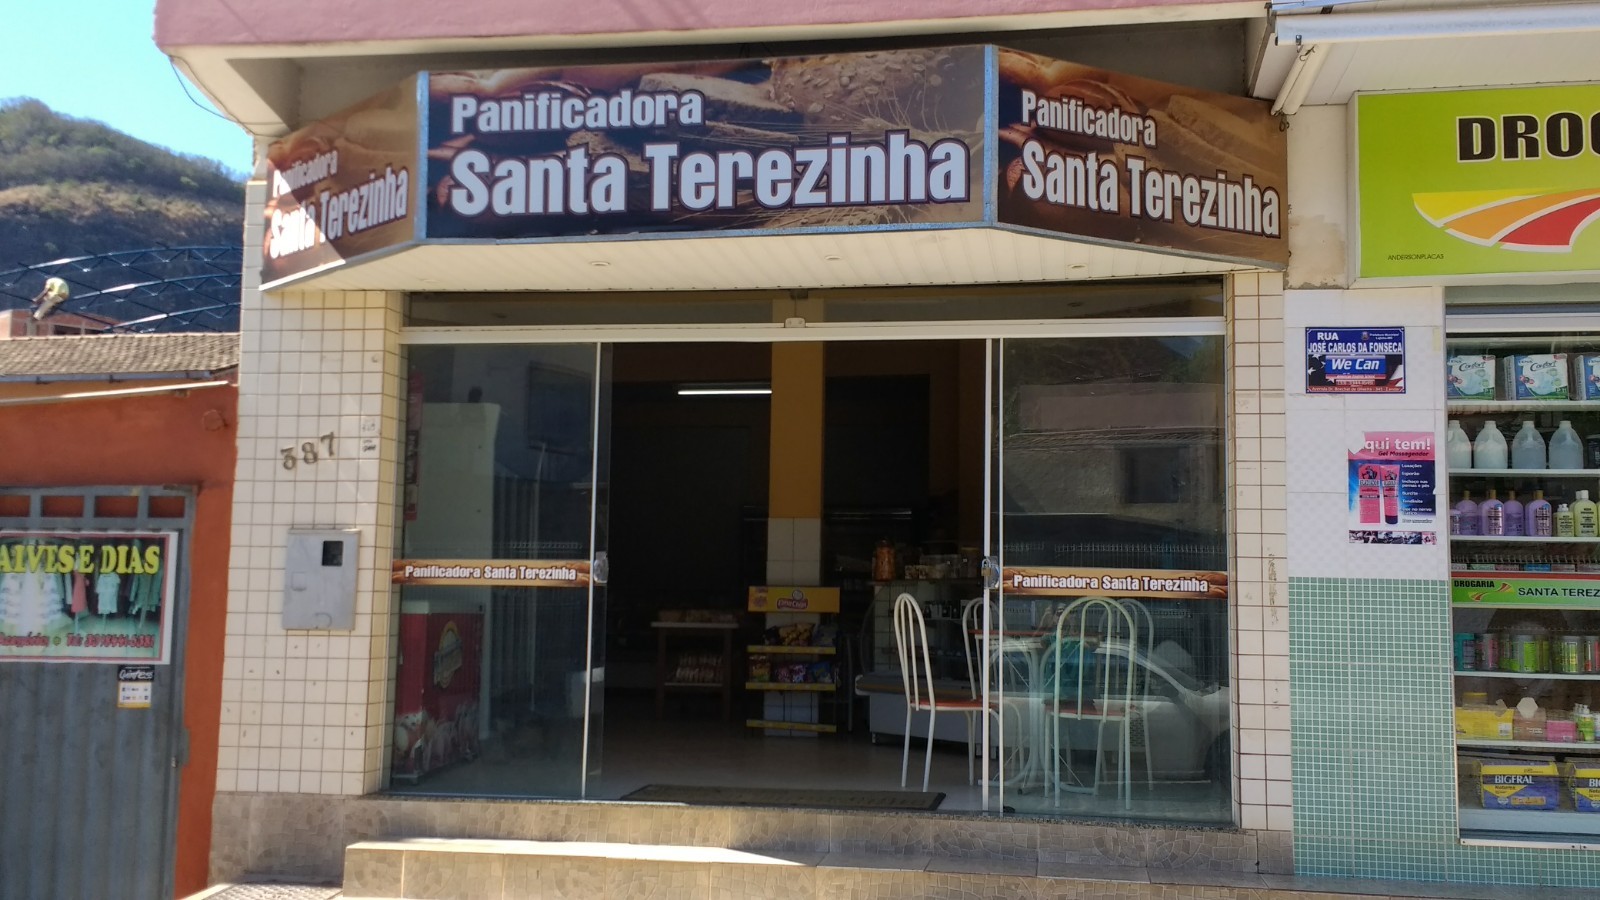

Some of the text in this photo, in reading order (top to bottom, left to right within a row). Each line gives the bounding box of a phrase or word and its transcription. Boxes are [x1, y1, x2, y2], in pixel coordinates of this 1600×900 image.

[452, 89, 703, 133] Panificadora
[1021, 89, 1157, 147] Panificadora
[1456, 110, 1600, 163] DRO
[273, 150, 338, 198] Panificadora
[451, 131, 971, 216] Santa Terezinha
[1022, 139, 1282, 238] Santa Terezinha
[269, 166, 409, 259] Santa Terezinha
[1308, 340, 1402, 353] JOSÉ CARLOS DA FONSECA
[1316, 331, 1340, 341] RUA
[1331, 358, 1380, 370] We Can
[280, 432, 335, 471] 387
[1394, 438, 1431, 450] tem!
[100, 545, 161, 575] DIAS
[404, 565, 577, 581] Panificadora Santa Terezinha
[1013, 574, 1208, 592] Panificadora Santa Terezinha
[1454, 580, 1600, 598] DROGARIA SANTA TEREZ
[1494, 775, 1534, 784] BIGFRAL
